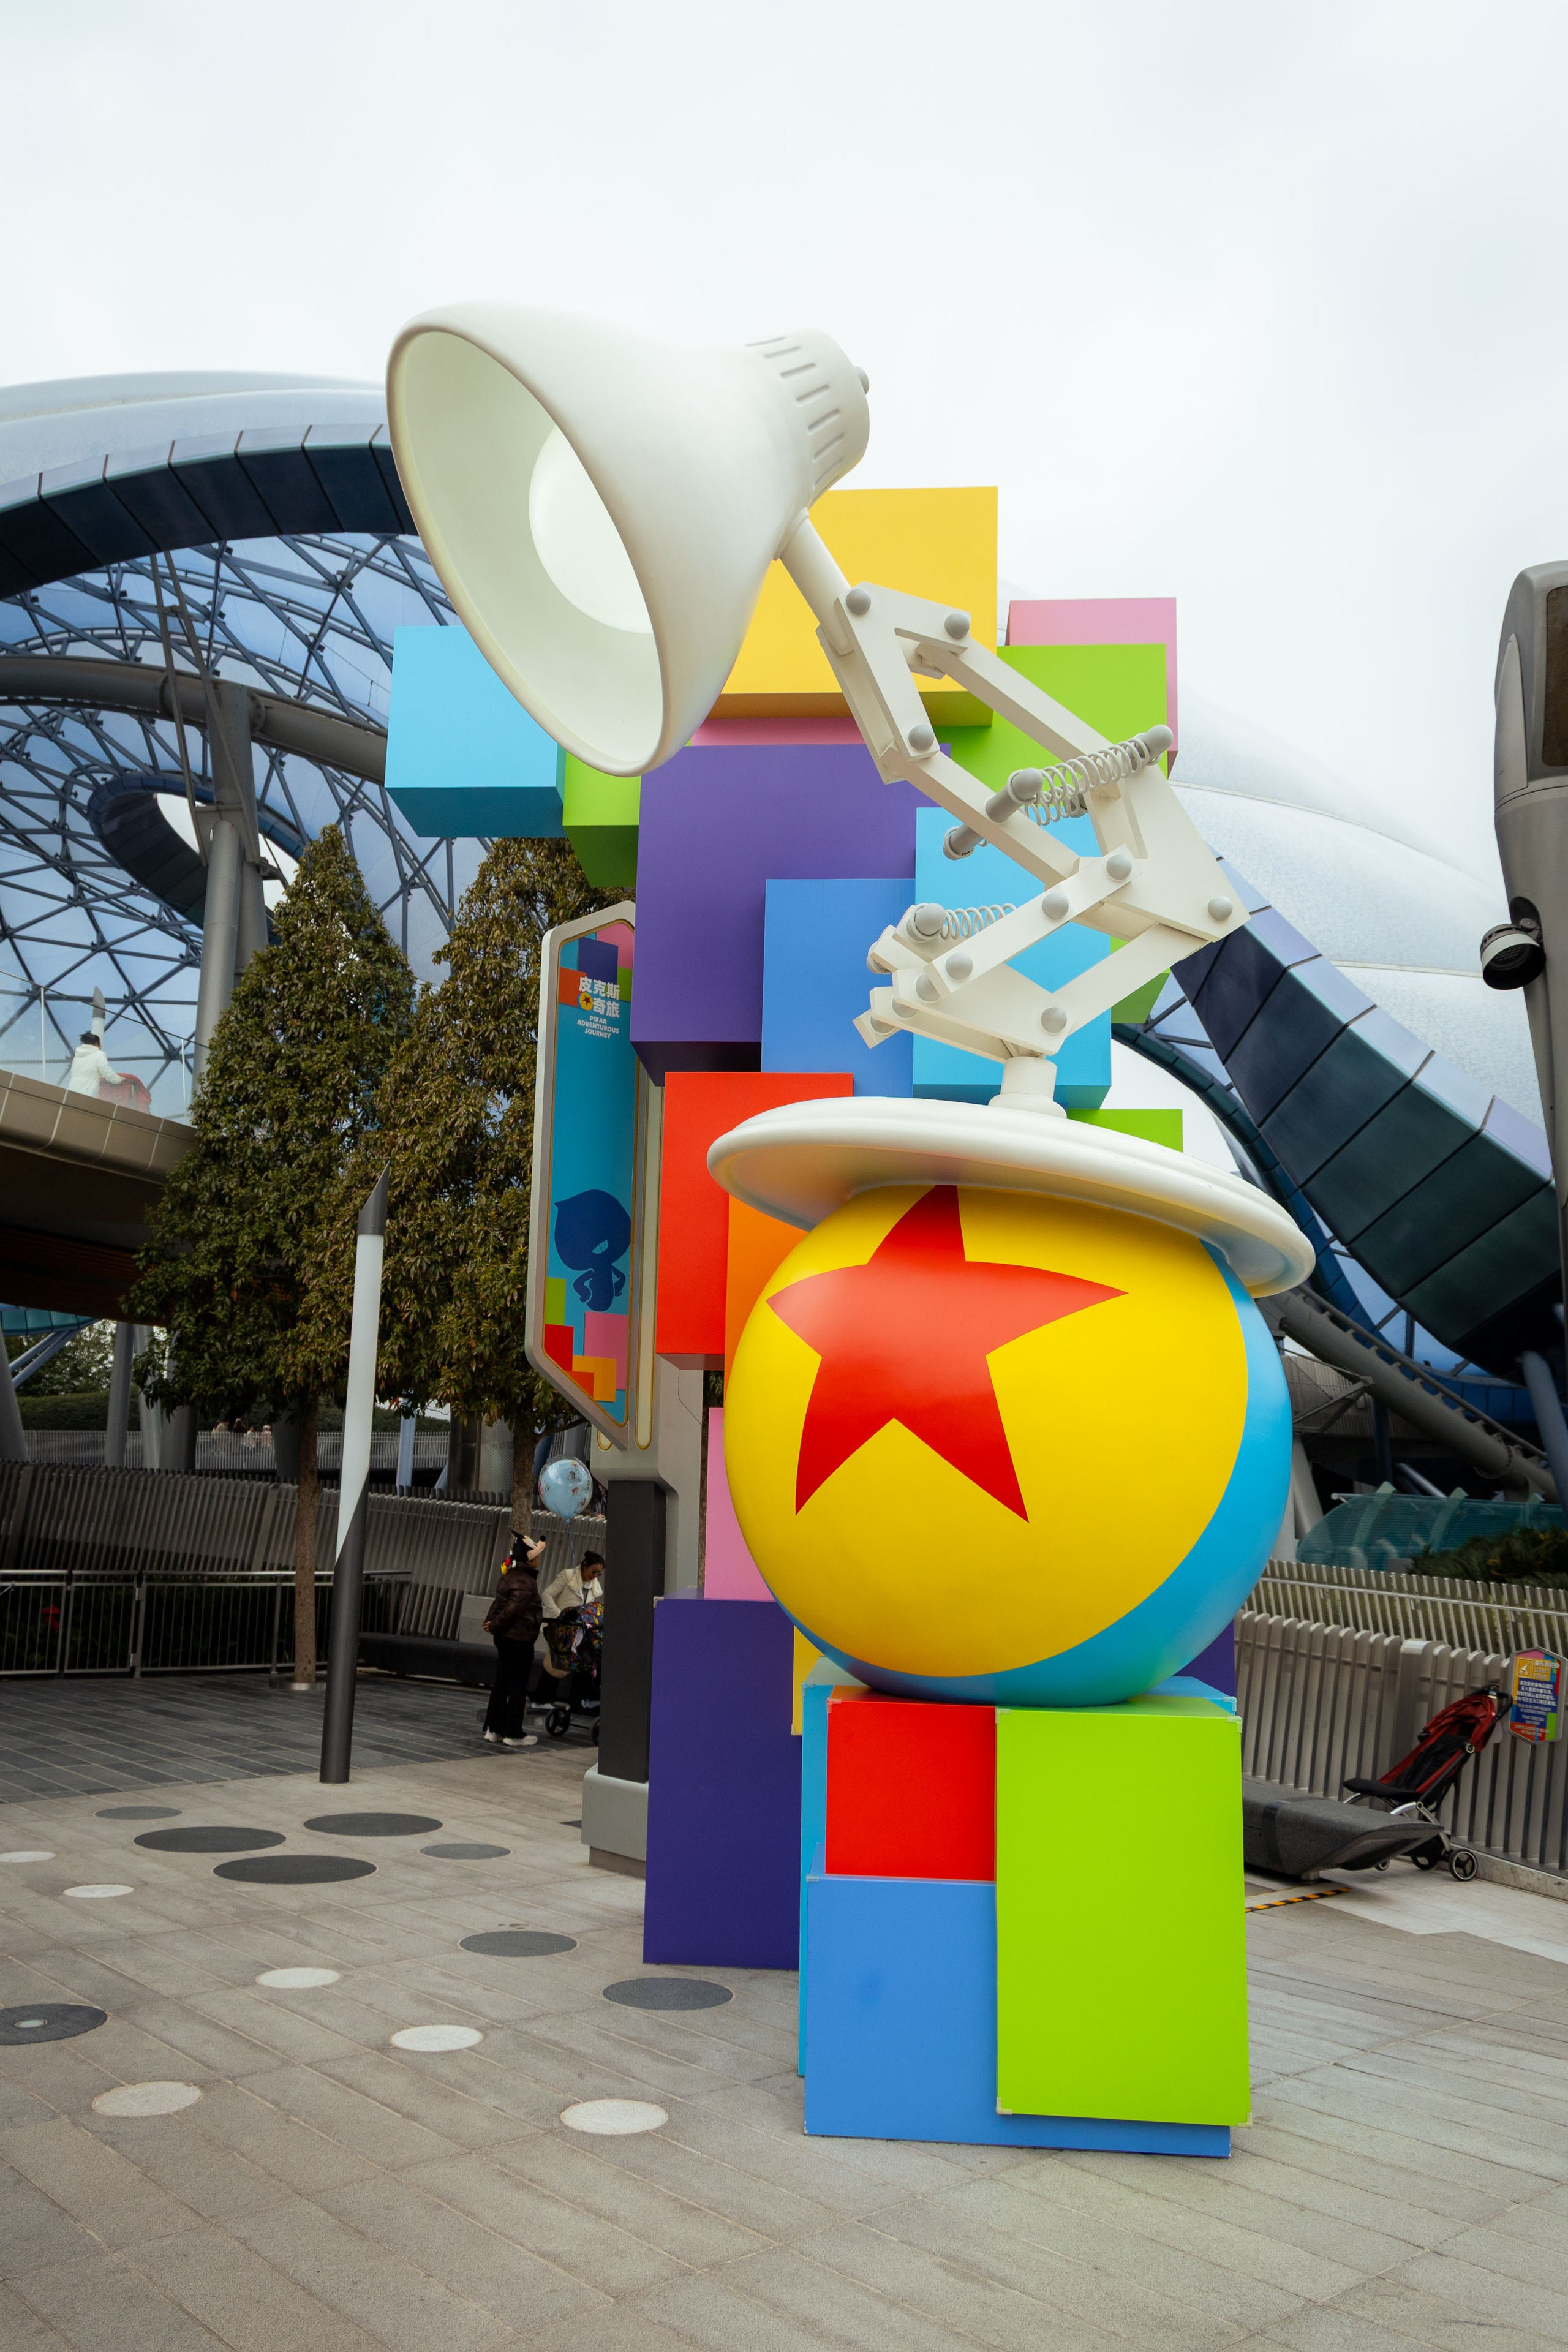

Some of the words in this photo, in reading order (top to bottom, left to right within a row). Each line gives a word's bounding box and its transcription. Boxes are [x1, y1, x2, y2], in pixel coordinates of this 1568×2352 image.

[579, 976, 620, 1000] 皮克斯
[593, 998, 620, 1018] 奇旅
[590, 1015, 607, 1024] PIXAR
[577, 1020, 619, 1034] ADVENTUROUS
[584, 1028, 611, 1039] JOURNEY
